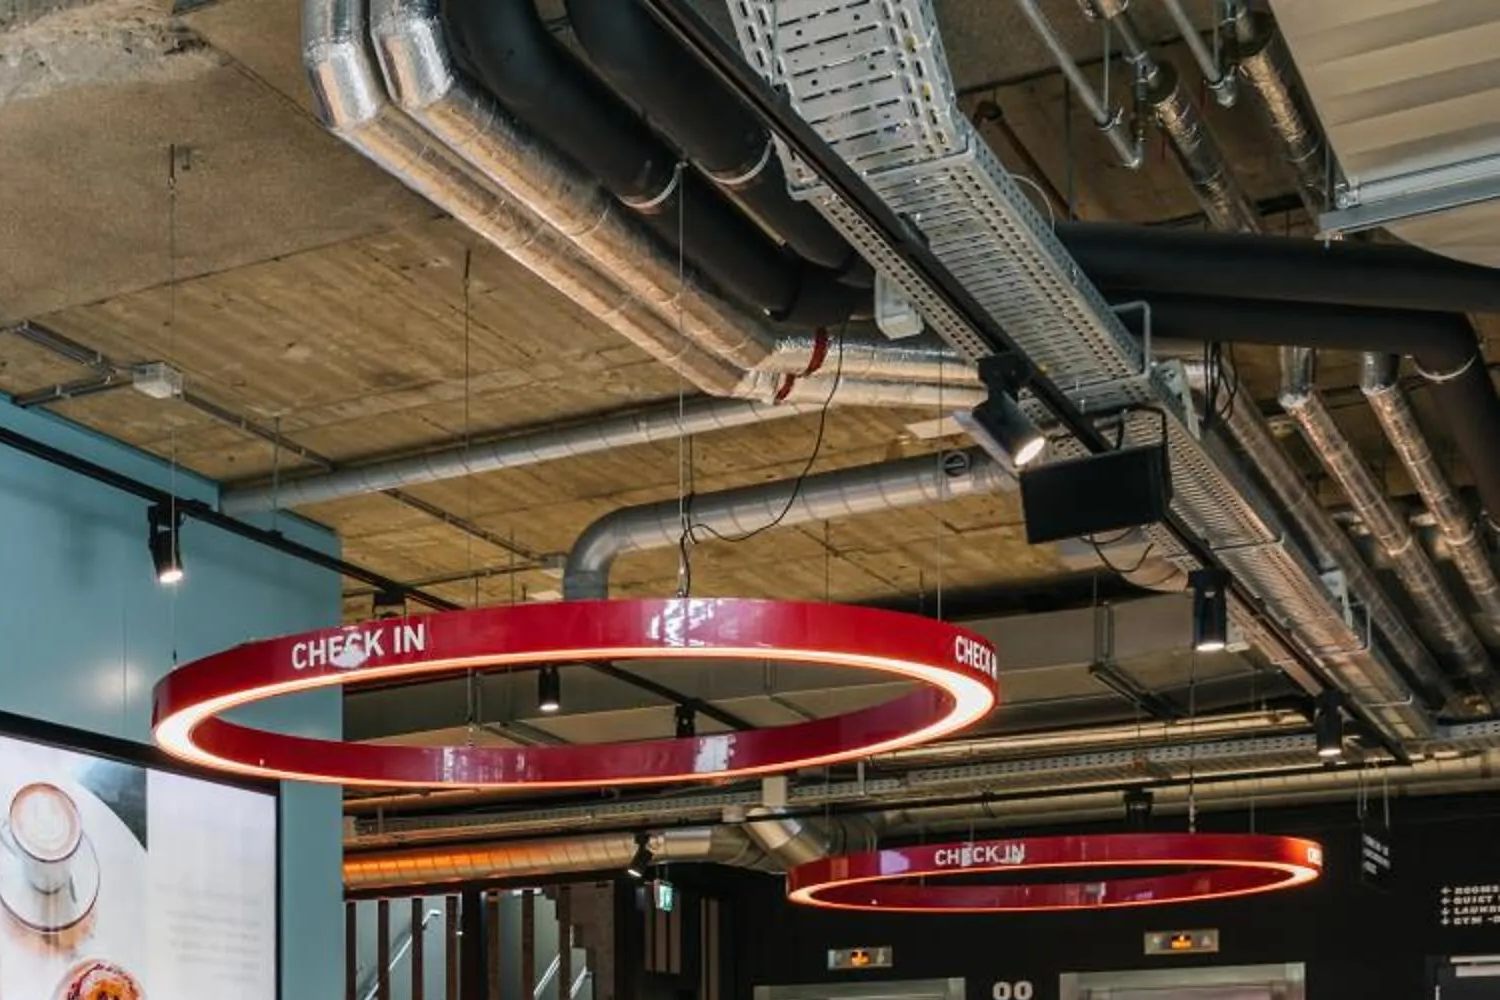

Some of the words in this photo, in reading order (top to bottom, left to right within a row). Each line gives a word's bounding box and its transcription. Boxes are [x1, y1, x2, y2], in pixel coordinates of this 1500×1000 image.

[292, 628, 385, 669] CHECK
[394, 624, 425, 653] IN
[934, 846, 999, 866] CHECK
[1004, 843, 1025, 864] IN
